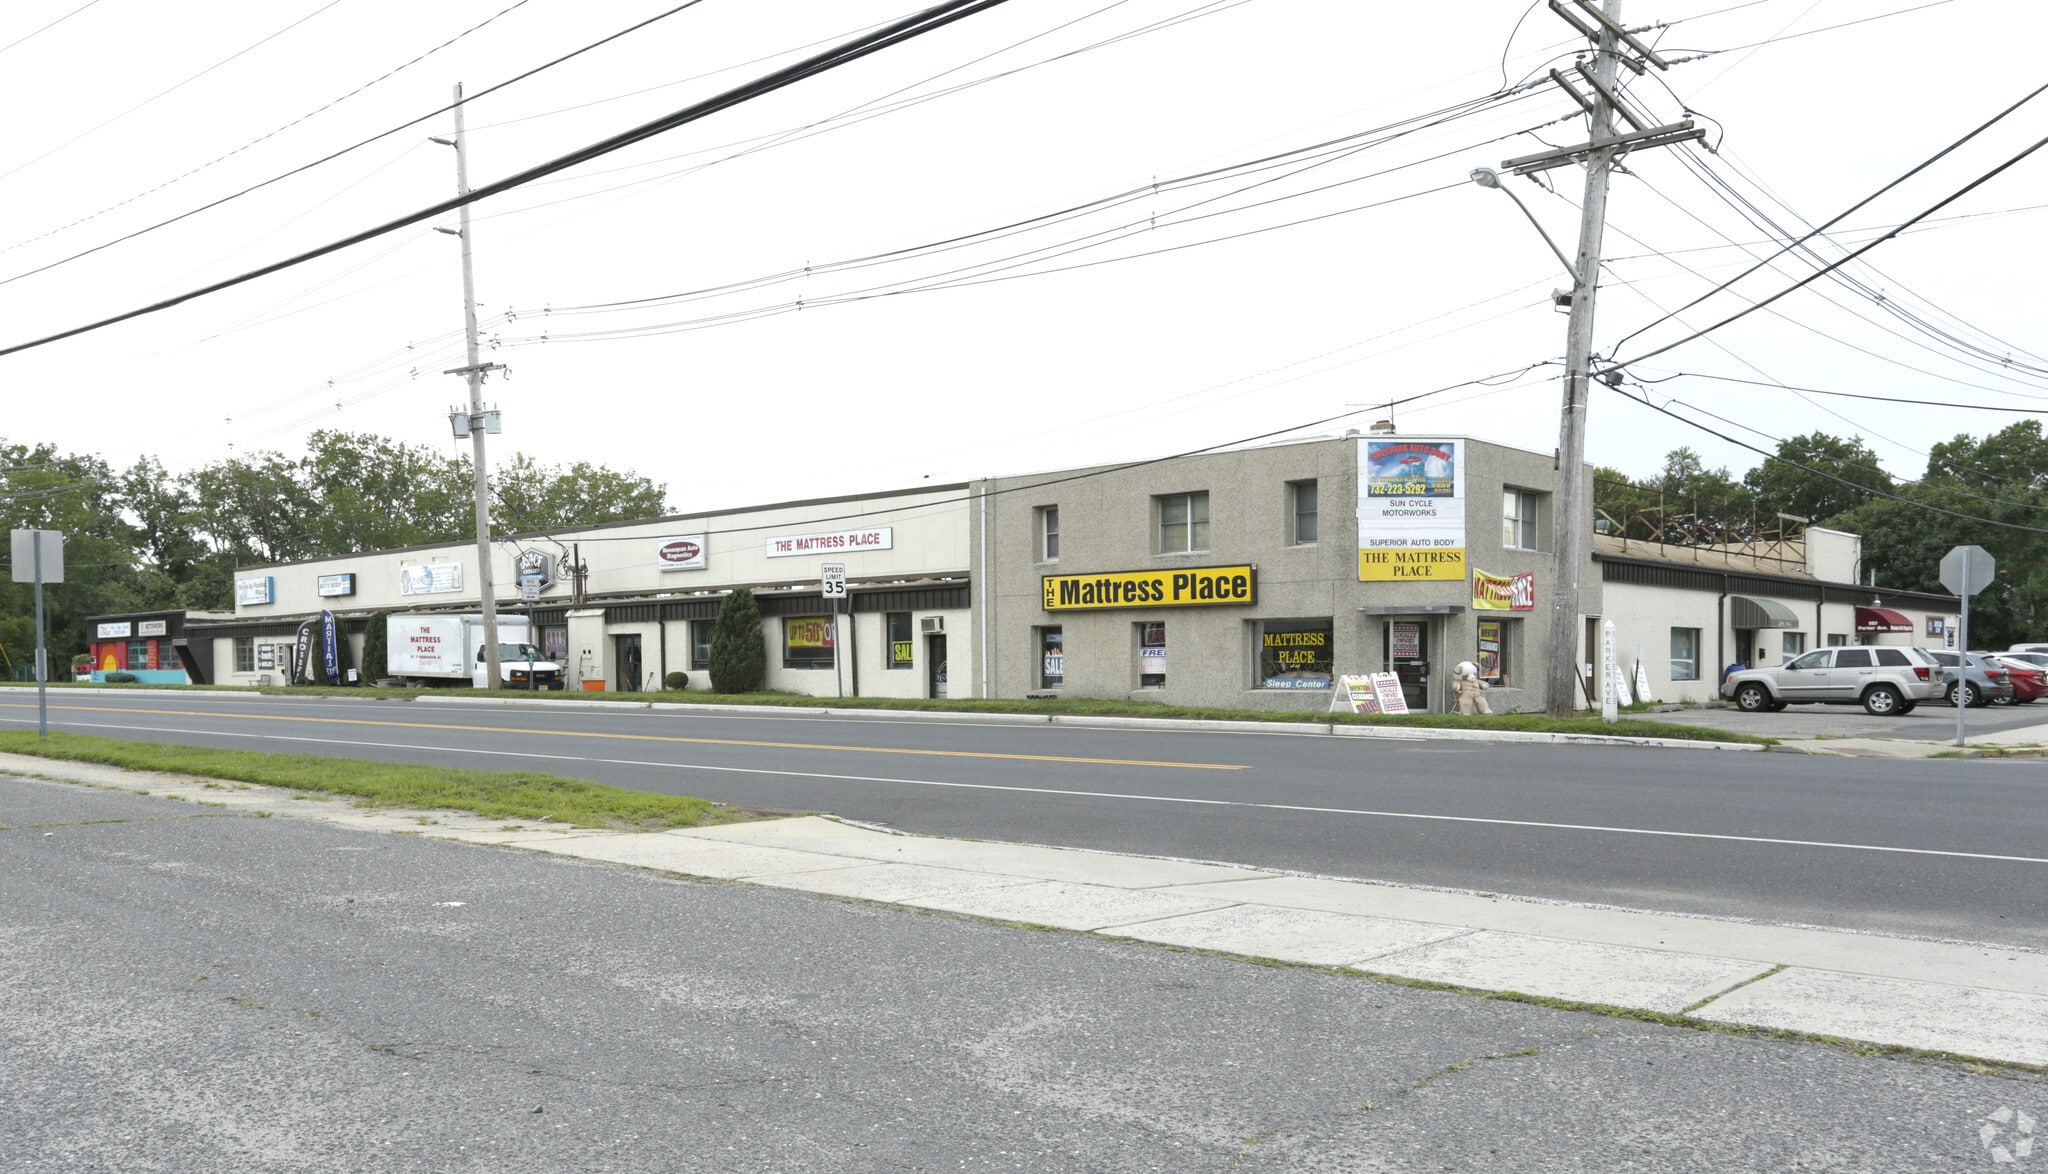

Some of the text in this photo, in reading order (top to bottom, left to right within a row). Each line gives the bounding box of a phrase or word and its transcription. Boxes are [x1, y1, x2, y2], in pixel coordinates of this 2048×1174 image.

[1370, 444, 1452, 462] SUPERIOR AUTO BODY
[1370, 484, 1426, 495] 732-223-5292
[1382, 509, 1437, 517] MOTORWORKS
[775, 532, 880, 552] THE MATTRESS PLACE
[1370, 539, 1407, 547] SUPERIOR
[1363, 552, 1461, 563] THE MATTRESS
[1393, 565, 1432, 577] PLACE
[825, 581, 844, 594] 35
[1046, 579, 1055, 607] THE
[1060, 573, 1248, 605] Mattress Place
[1510, 575, 1533, 606] SALE
[420, 626, 431, 634] THE
[410, 636, 441, 644] MATTRESS
[1264, 632, 1325, 647] MATTRESS
[417, 645, 435, 653] PLACE
[895, 643, 913, 661] SAL
[1278, 650, 1315, 664] PLACE
[1045, 658, 1063, 674] SALE
[1266, 679, 1326, 689] Sleep Center
